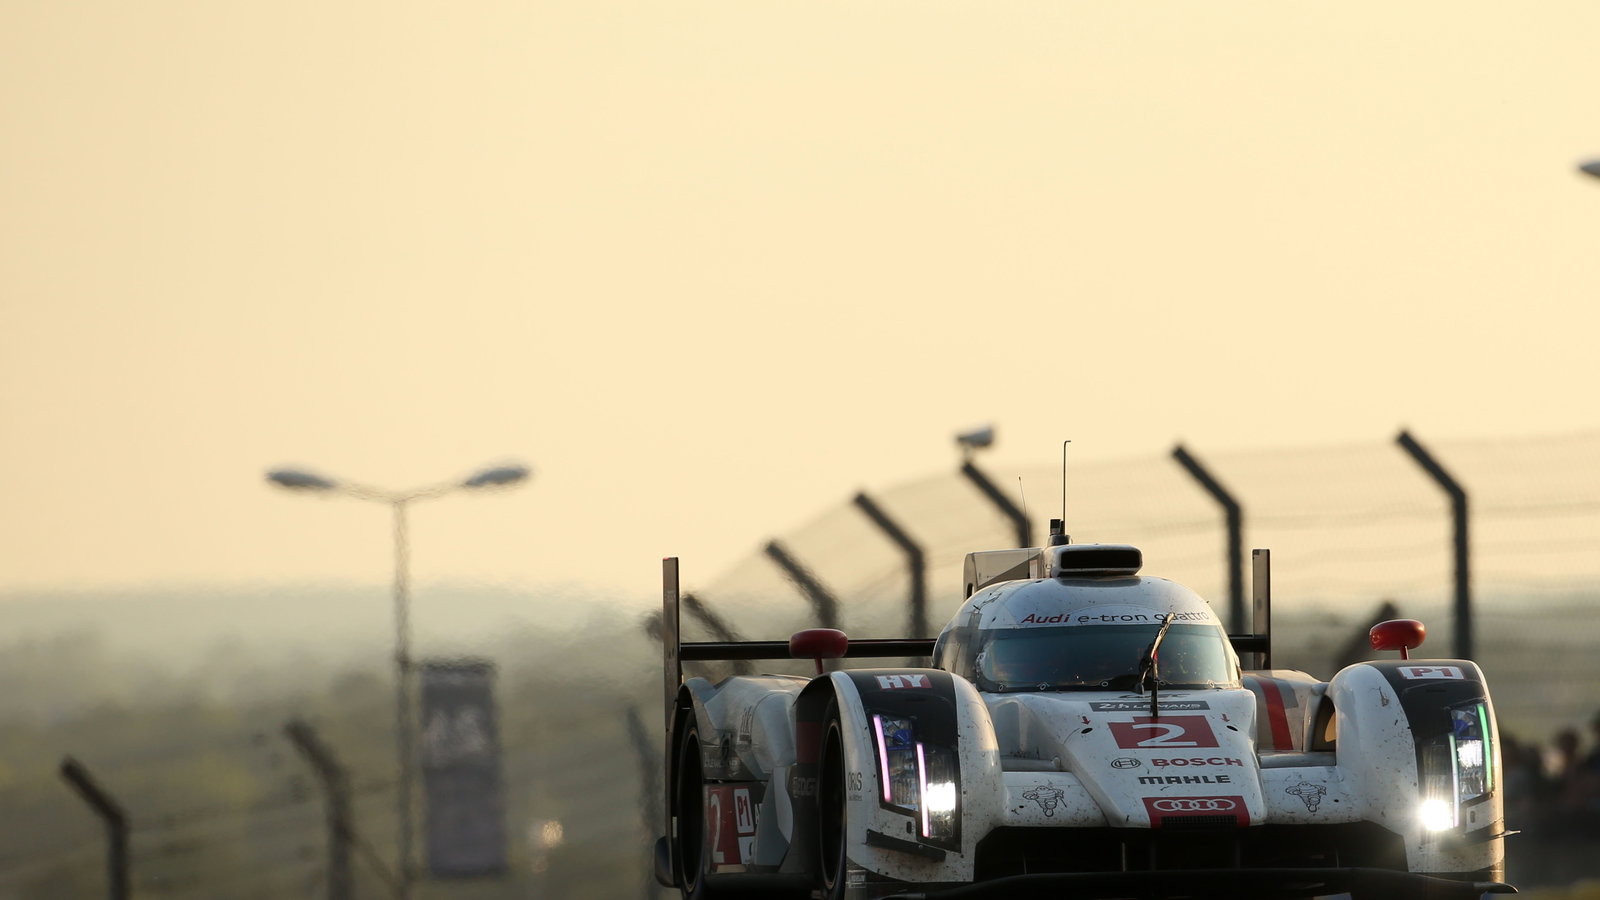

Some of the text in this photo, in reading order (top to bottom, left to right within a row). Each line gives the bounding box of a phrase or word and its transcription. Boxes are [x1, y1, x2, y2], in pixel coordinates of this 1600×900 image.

[1021, 613, 1070, 624] Audi
[1077, 613, 1148, 623] e-tron
[1410, 668, 1453, 676] P1
[877, 675, 923, 688] HY
[1132, 723, 1198, 747] 2
[1153, 758, 1243, 767] BOSCH
[1139, 775, 1231, 785] MAHLE
[738, 796, 750, 827] P1
[710, 793, 725, 863] 2
